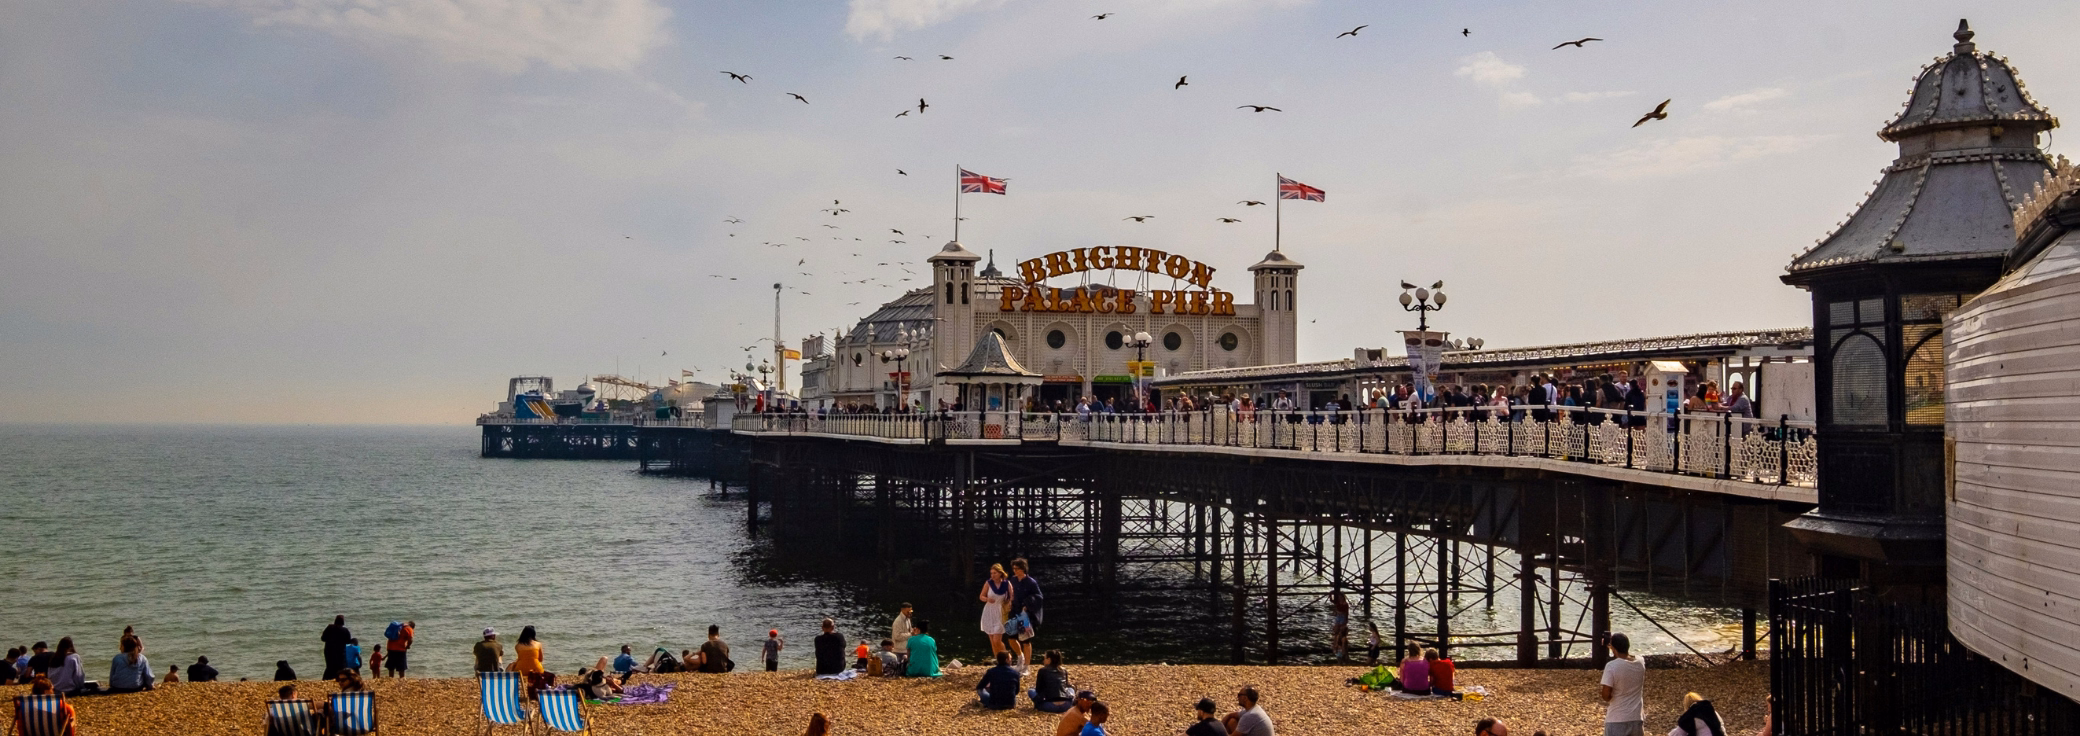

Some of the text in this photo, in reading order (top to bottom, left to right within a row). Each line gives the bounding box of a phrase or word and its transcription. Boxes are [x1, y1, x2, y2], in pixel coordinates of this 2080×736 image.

[1018, 245, 1216, 289] BRIGHTON
[1000, 286, 1236, 316] PALACE PIER
